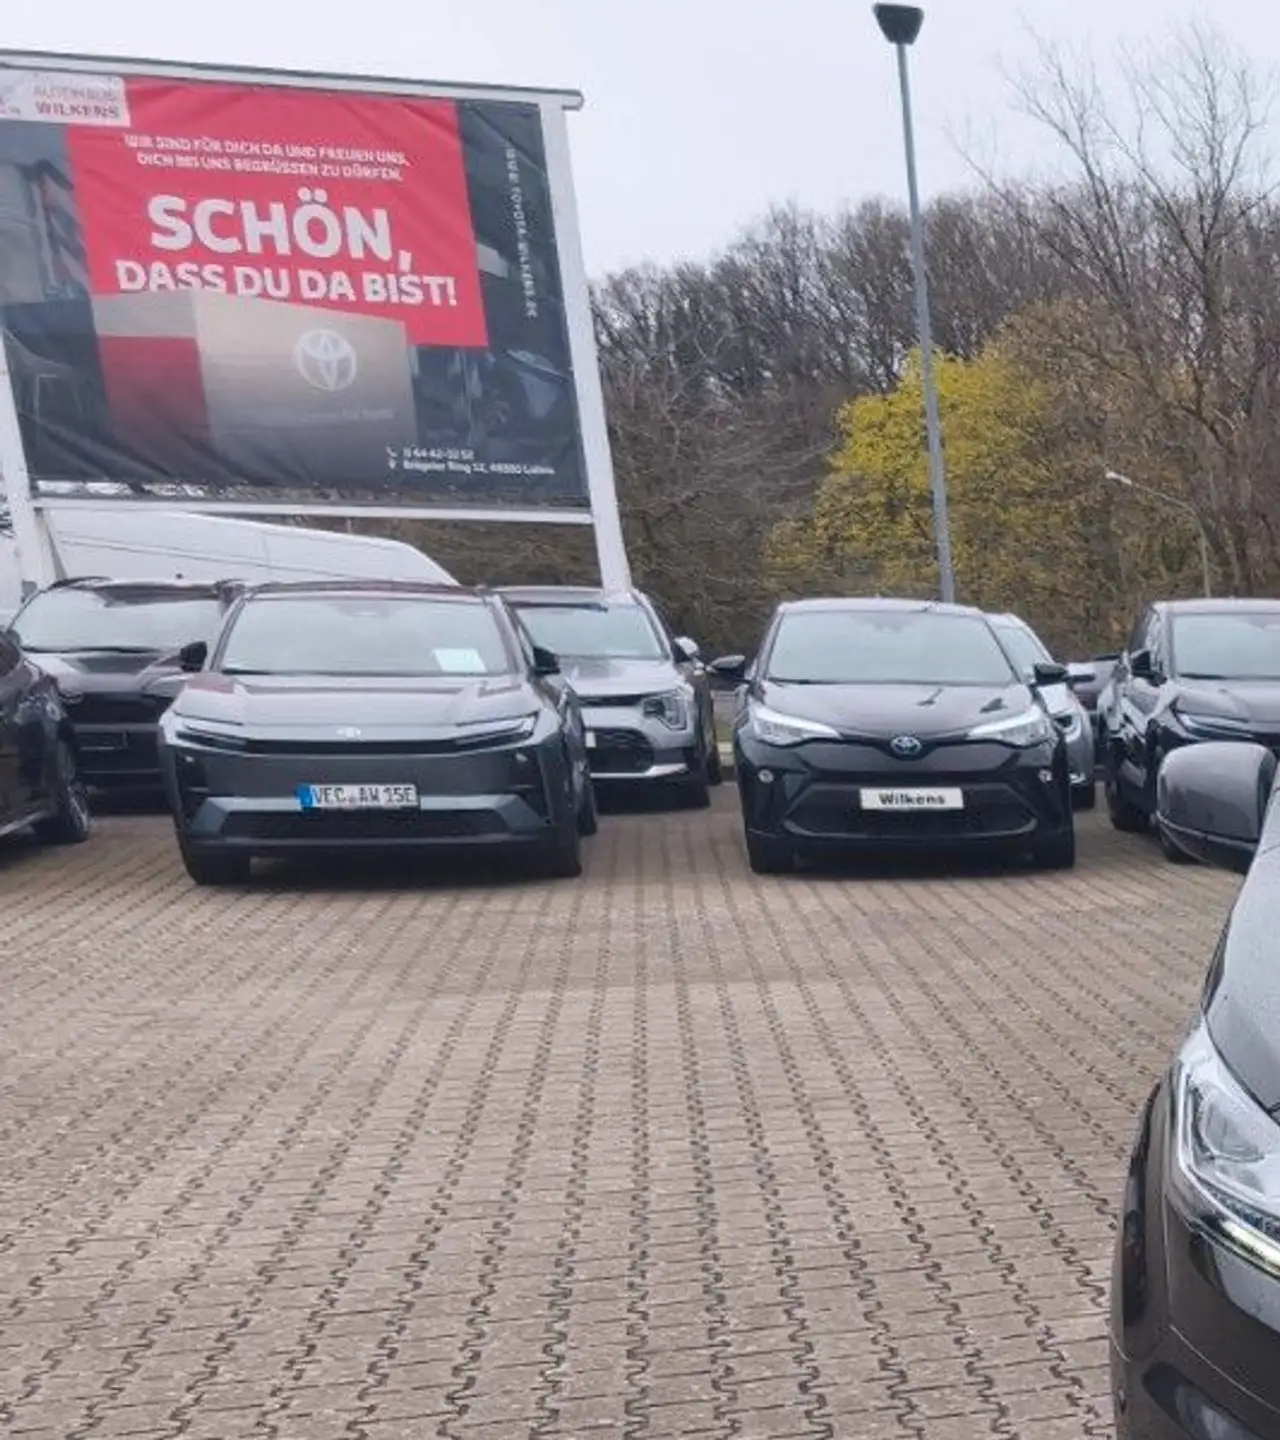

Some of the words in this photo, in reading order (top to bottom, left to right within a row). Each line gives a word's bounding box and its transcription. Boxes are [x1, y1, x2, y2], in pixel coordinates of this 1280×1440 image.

[35, 101, 120, 118] WILKENS
[156, 136, 191, 151] SIND
[224, 139, 261, 154] DICH
[261, 143, 284, 157] DA
[286, 144, 316, 158] UND
[201, 154, 232, 170] UNS
[321, 163, 340, 177] ZU
[147, 187, 412, 273] SCHÖN,
[115, 259, 228, 294] DASS
[233, 265, 290, 300] DU
[298, 269, 356, 302] DA
[362, 272, 457, 307] BIST!
[311, 786, 346, 803] VEC
[359, 787, 380, 803] AW
[382, 787, 414, 803] 15E
[878, 792, 946, 805] Wilkens
